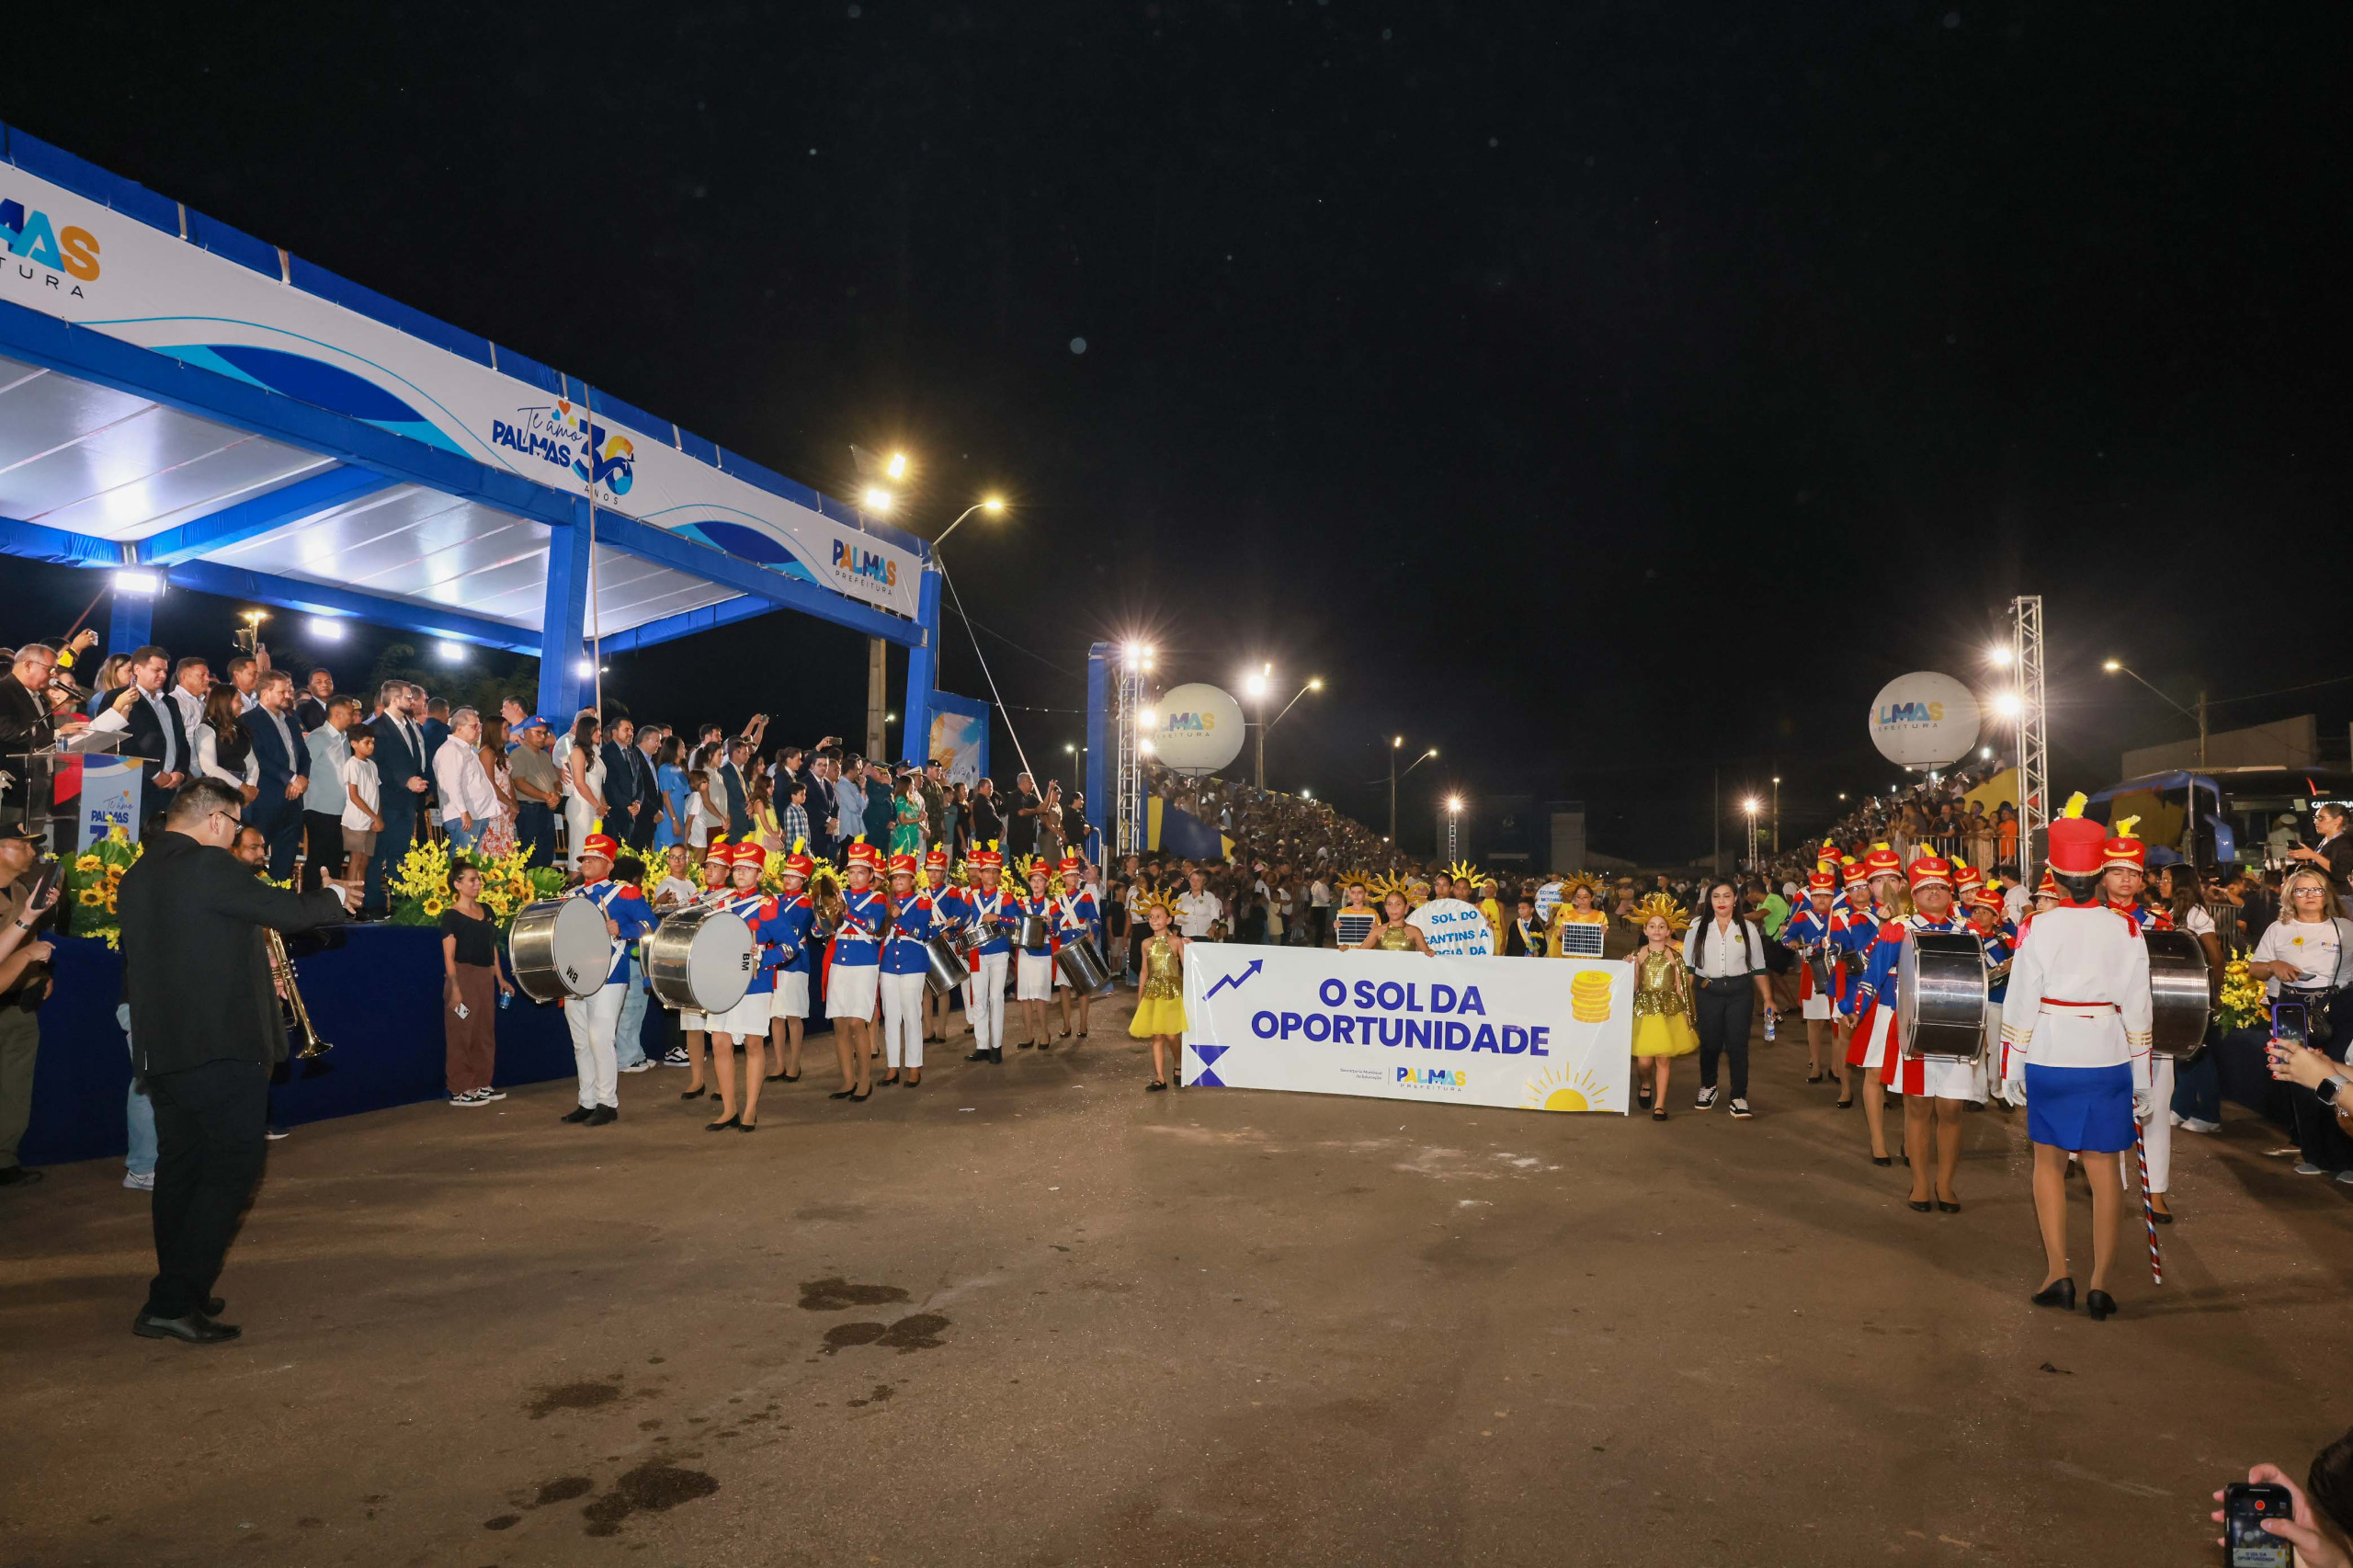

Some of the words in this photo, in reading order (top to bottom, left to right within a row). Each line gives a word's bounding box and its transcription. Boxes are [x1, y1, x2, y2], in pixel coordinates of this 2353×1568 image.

[517, 406, 551, 445] Te
[546, 419, 583, 442] amo
[492, 419, 572, 468] PALMAS
[584, 484, 619, 505] ANOS
[832, 538, 897, 586] PALMAS
[835, 570, 892, 596] PREFEITURA
[1431, 912, 1457, 925] SOL
[1461, 910, 1478, 921] DO
[1480, 928, 1489, 938] A
[1469, 945, 1487, 956] DA
[741, 952, 750, 971] BM
[565, 965, 579, 984] BM
[1319, 978, 1347, 1007] O
[1353, 980, 1424, 1012] SOL
[1430, 983, 1486, 1016] DA
[1251, 1010, 1551, 1056] OPORTUNIDADE
[1396, 1066, 1467, 1086] PALMAS
[1400, 1084, 1461, 1092] PREFEITURA
